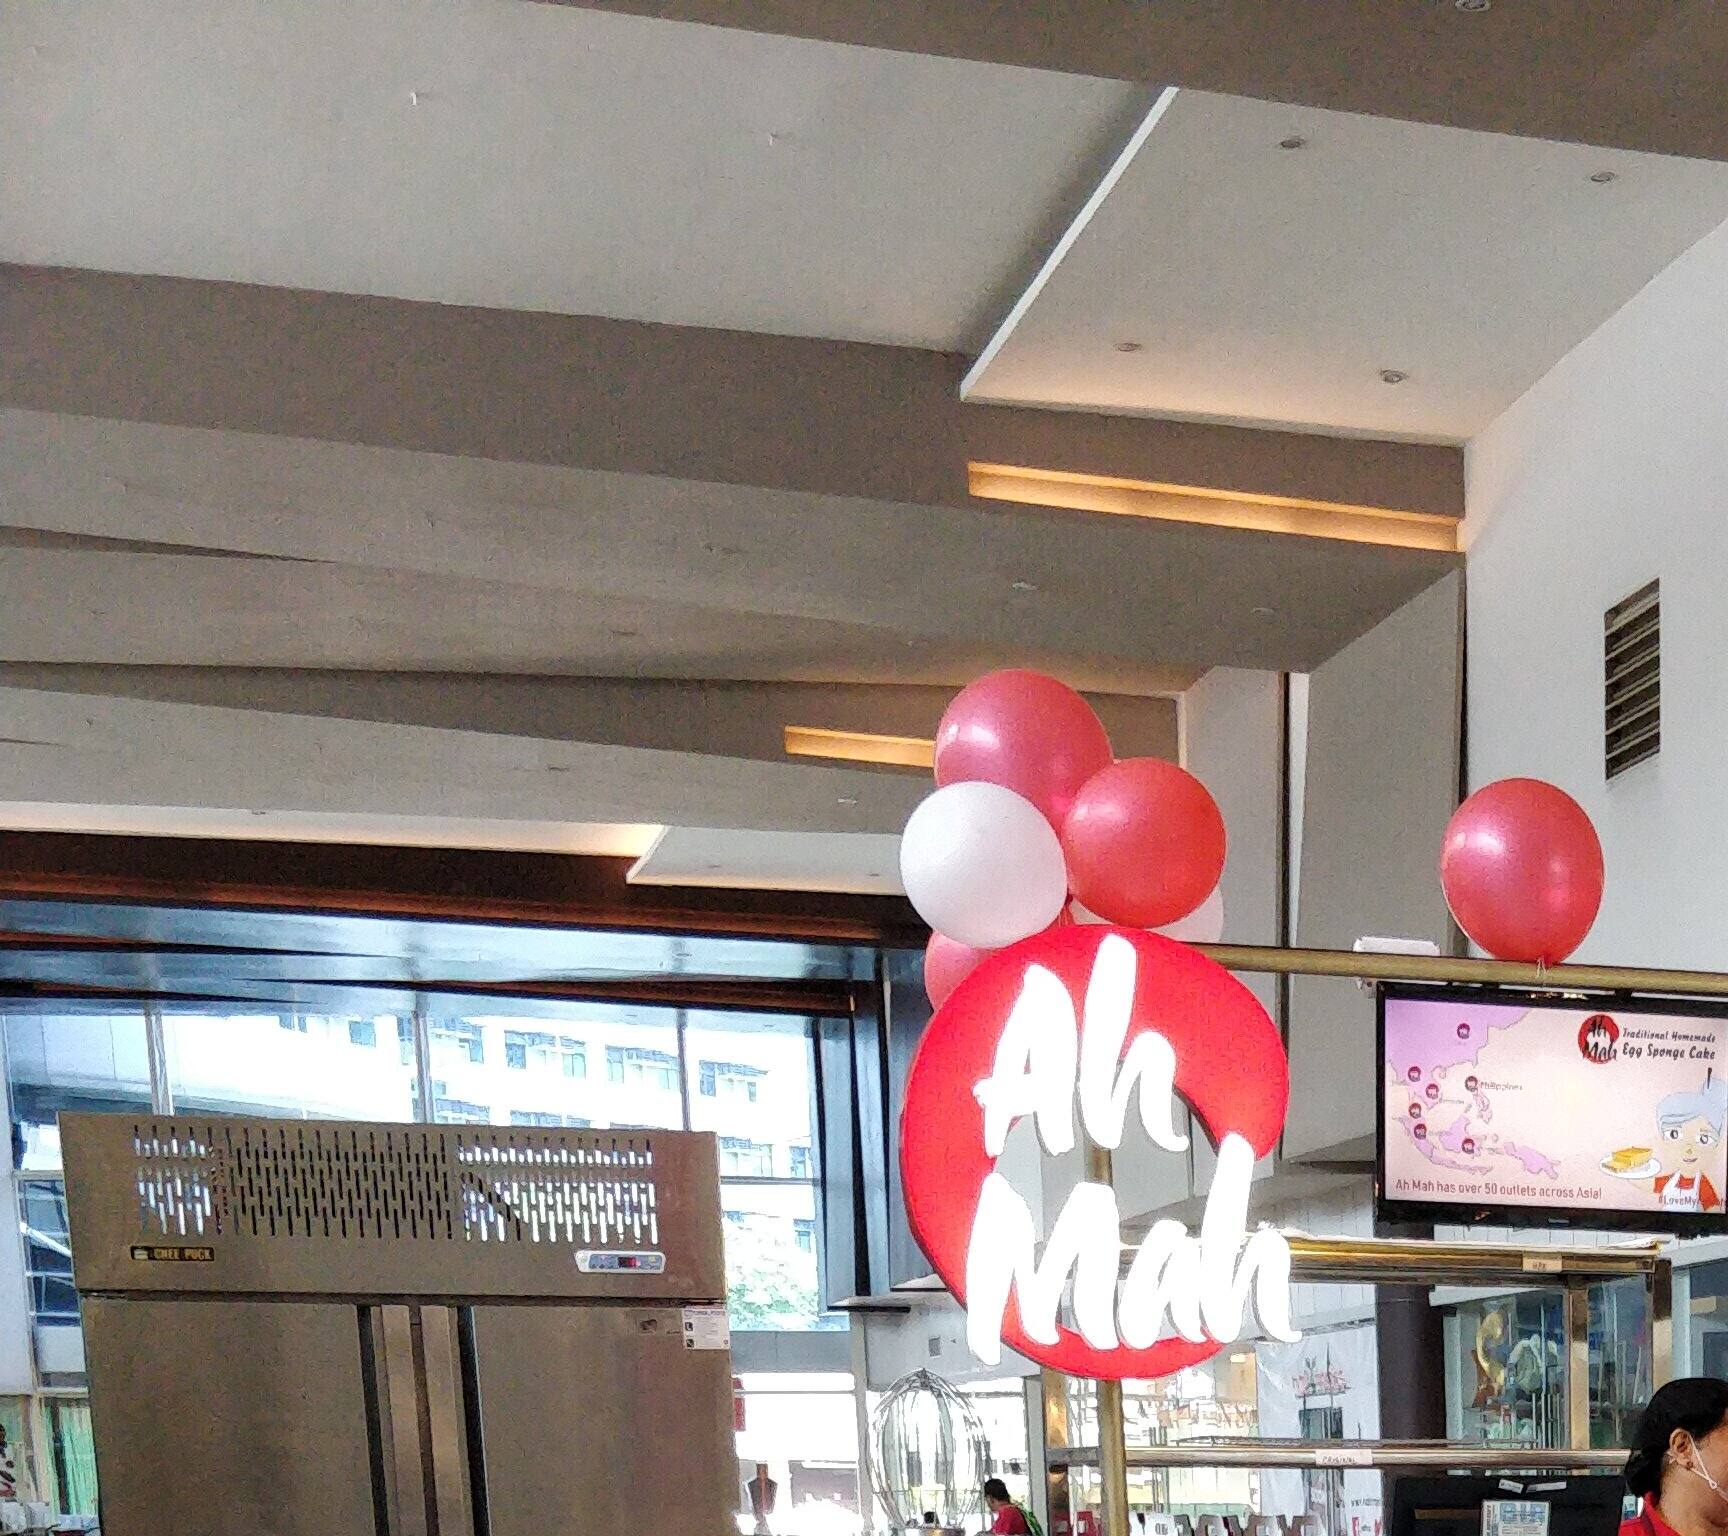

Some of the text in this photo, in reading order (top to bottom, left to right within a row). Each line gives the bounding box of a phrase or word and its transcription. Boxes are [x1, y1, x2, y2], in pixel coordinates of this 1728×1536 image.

[972, 933, 1189, 1157] Ah
[1623, 1028, 1715, 1043] Traditional Homemade
[1623, 1043, 1715, 1060] Egg Sponge Cake
[1395, 1179, 1410, 1190] Ah
[1412, 1180, 1434, 1191] Mah
[1436, 1181, 1456, 1193] has
[1458, 1184, 1482, 1194] over
[1484, 1183, 1497, 1195] 50
[1499, 1184, 1537, 1196] outlets
[1539, 1188, 1574, 1198] across
[965, 1133, 1302, 1365] Mah
